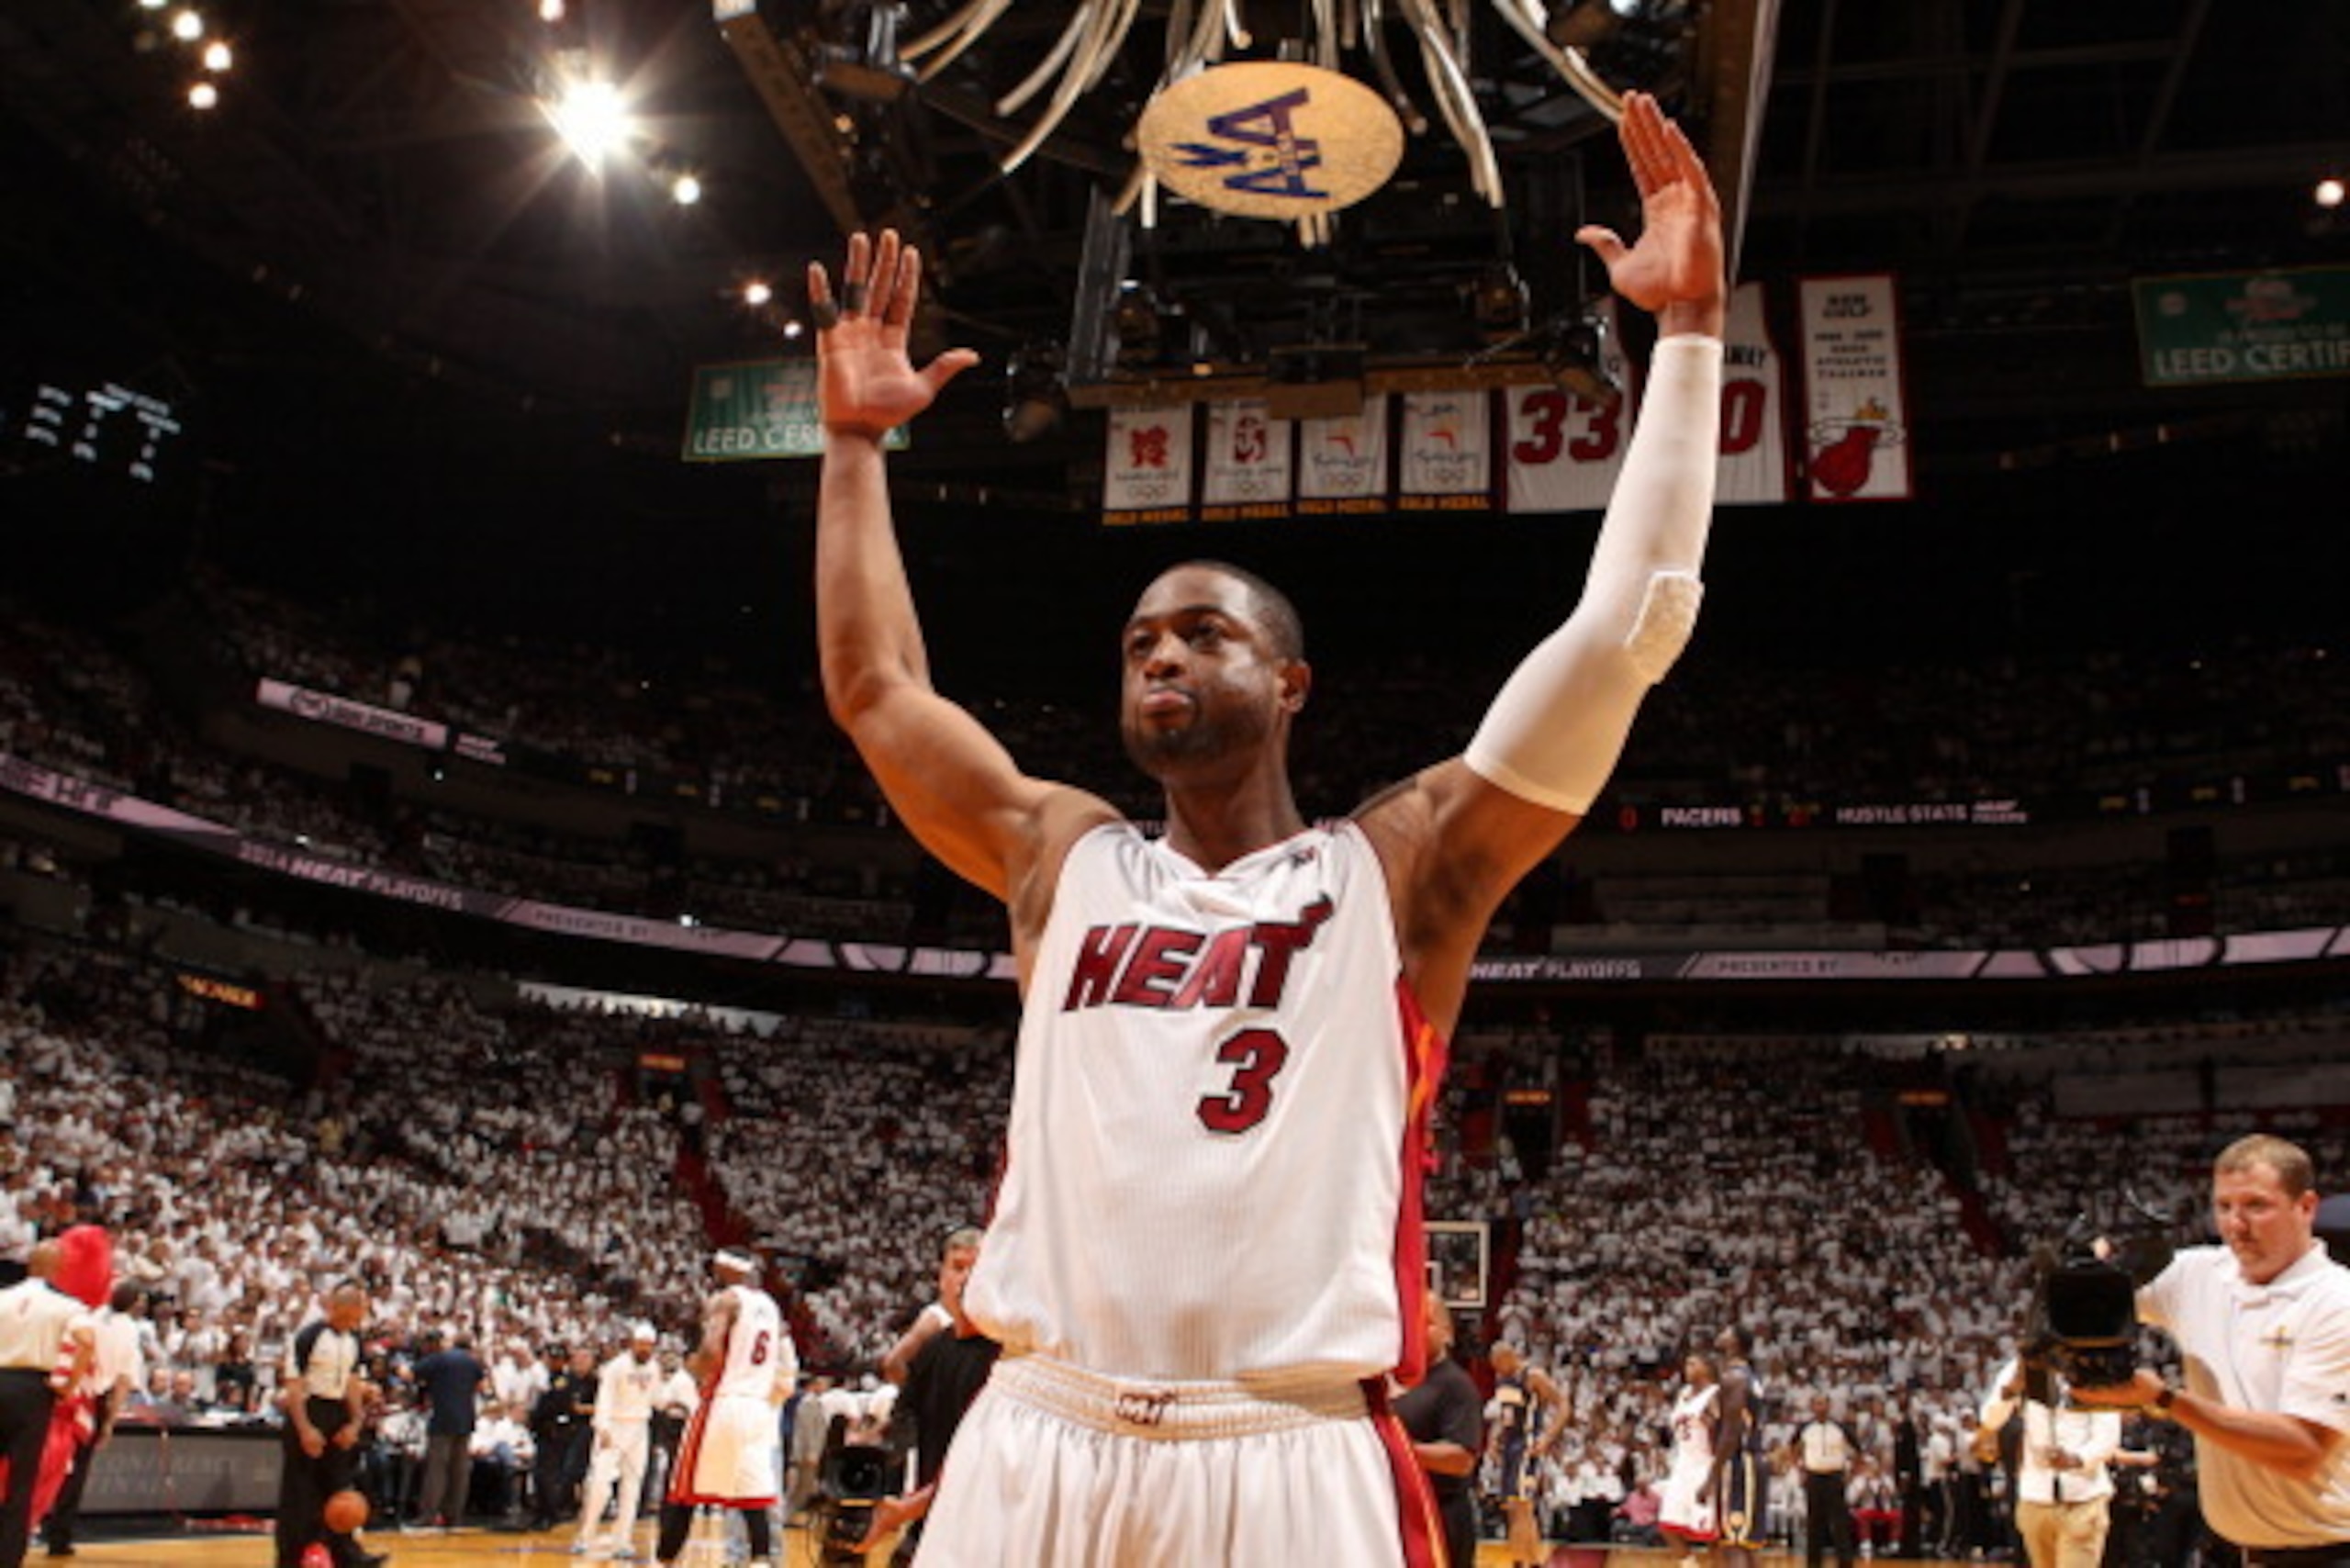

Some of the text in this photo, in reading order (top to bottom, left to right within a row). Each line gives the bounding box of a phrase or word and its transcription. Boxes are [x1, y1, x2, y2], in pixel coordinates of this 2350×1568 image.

[2154, 347, 2236, 379] LEED
[693, 426, 755, 454] LEED
[1513, 389, 1623, 465] 33
[1660, 806, 1743, 827] PACERS
[1836, 805, 1908, 825] HUSTLE
[1908, 802, 1968, 823] STATS
[288, 855, 372, 888] HEAT
[367, 871, 463, 913] PLAYOFFS
[1062, 903, 1334, 1013] HEAT
[1470, 958, 1642, 980] HEAT PLAYOFFS
[1196, 1027, 1289, 1136] 3
[750, 1329, 771, 1366] 6
